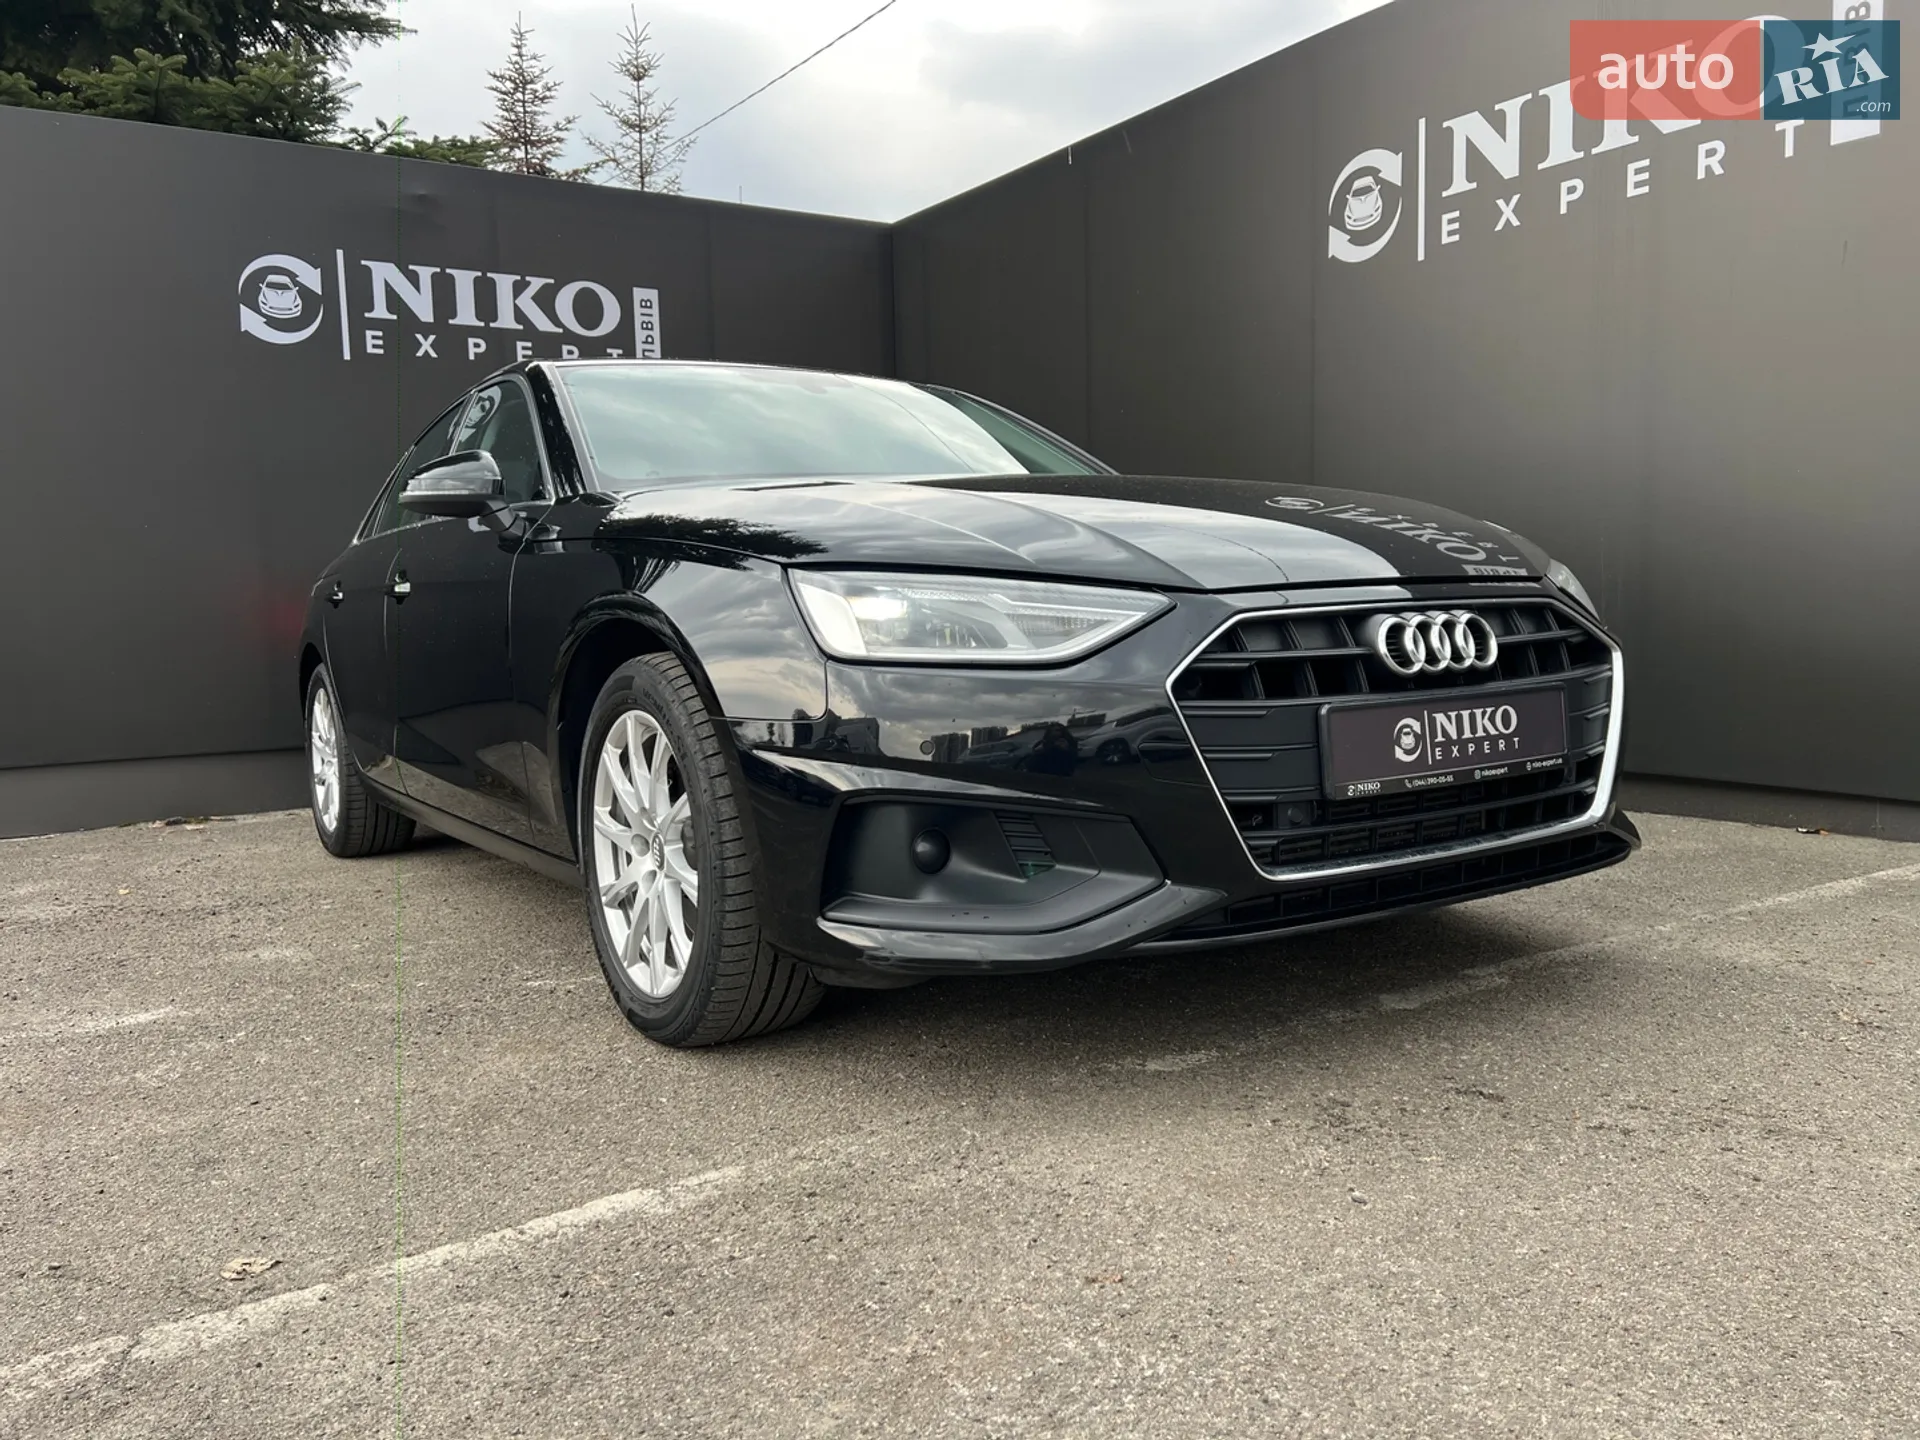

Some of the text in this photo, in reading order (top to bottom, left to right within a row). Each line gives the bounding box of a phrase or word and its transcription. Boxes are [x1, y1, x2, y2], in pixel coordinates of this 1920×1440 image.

[1441, 14, 1806, 198] NIKO
[1441, 118, 1805, 245] EXPERT
[360, 259, 622, 338] NIKO
[1432, 704, 1518, 742] NIKO
[1435, 737, 1520, 760] EXPERT
[1357, 781, 1381, 791] NIKO
